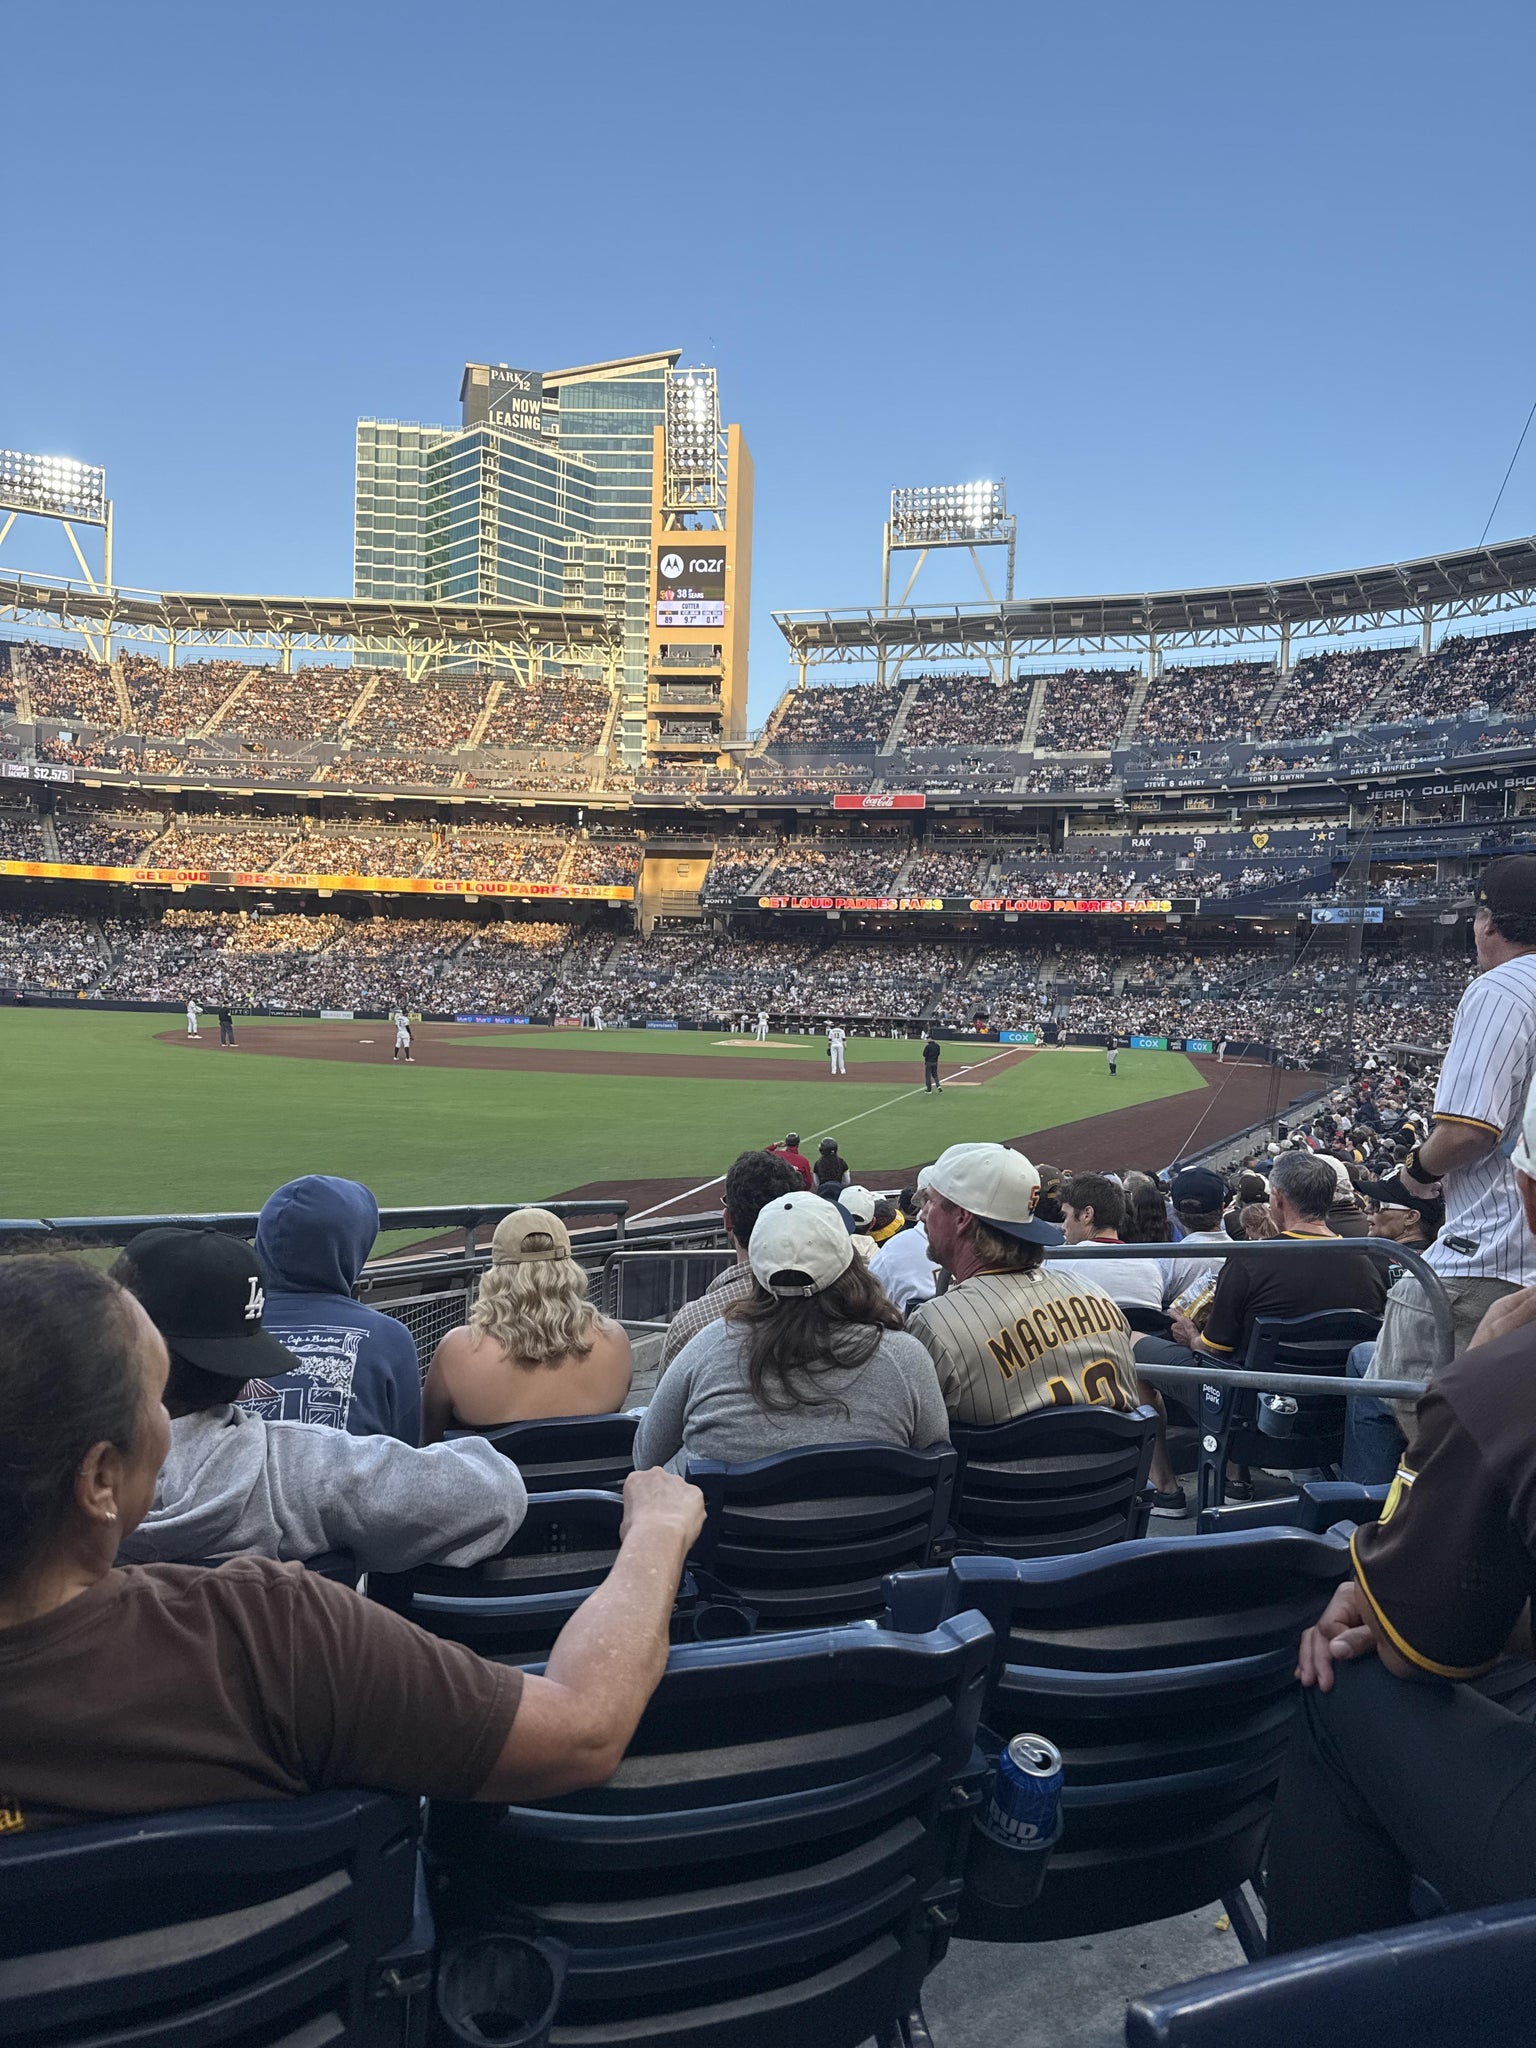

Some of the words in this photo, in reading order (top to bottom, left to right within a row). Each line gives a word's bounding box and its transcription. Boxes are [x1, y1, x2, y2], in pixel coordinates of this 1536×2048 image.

[491, 369, 523, 384] PARK
[519, 380, 531, 392] 12
[512, 397, 541, 415] NOW
[489, 410, 541, 431] LEASING
[689, 559, 724, 573] razr
[676, 588, 688, 599] 38
[8, 764, 30, 772] TODAY'S
[34, 767, 69, 781] $12,575
[1350, 768, 1369, 776] DAVE
[1370, 766, 1380, 774] 31
[1382, 763, 1416, 773] WINFIELD
[1169, 780, 1175, 788] 6
[1178, 779, 1206, 787] GARVEY
[1269, 774, 1278, 782] 19
[1280, 773, 1305, 781] GWYNN
[1366, 788, 1415, 801] JERRY
[1421, 780, 1499, 796] COLEMAN
[1132, 838, 1151, 847] RAK
[434, 881, 463, 891] GET
[466, 882, 507, 893] LOUD
[510, 884, 570, 896] PADRES
[759, 896, 790, 909] GET
[791, 897, 833, 909] LOUD
[835, 898, 898, 911] PADRES
[899, 898, 944, 911] FANS
[969, 900, 1003, 911] GET
[1005, 899, 1052, 912] LOUD
[1053, 900, 1123, 912] PADRES
[1124, 900, 1173, 912] FANS
[1009, 1034, 1029, 1042] COX
[1139, 1039, 1159, 1048] COX
[1192, 1042, 1208, 1051] COX
[244, 1276, 266, 1320] LA
[986, 1295, 1125, 1380] MACHADO
[1202, 1383, 1221, 1397] petco
[1205, 1392, 1220, 1405] park
